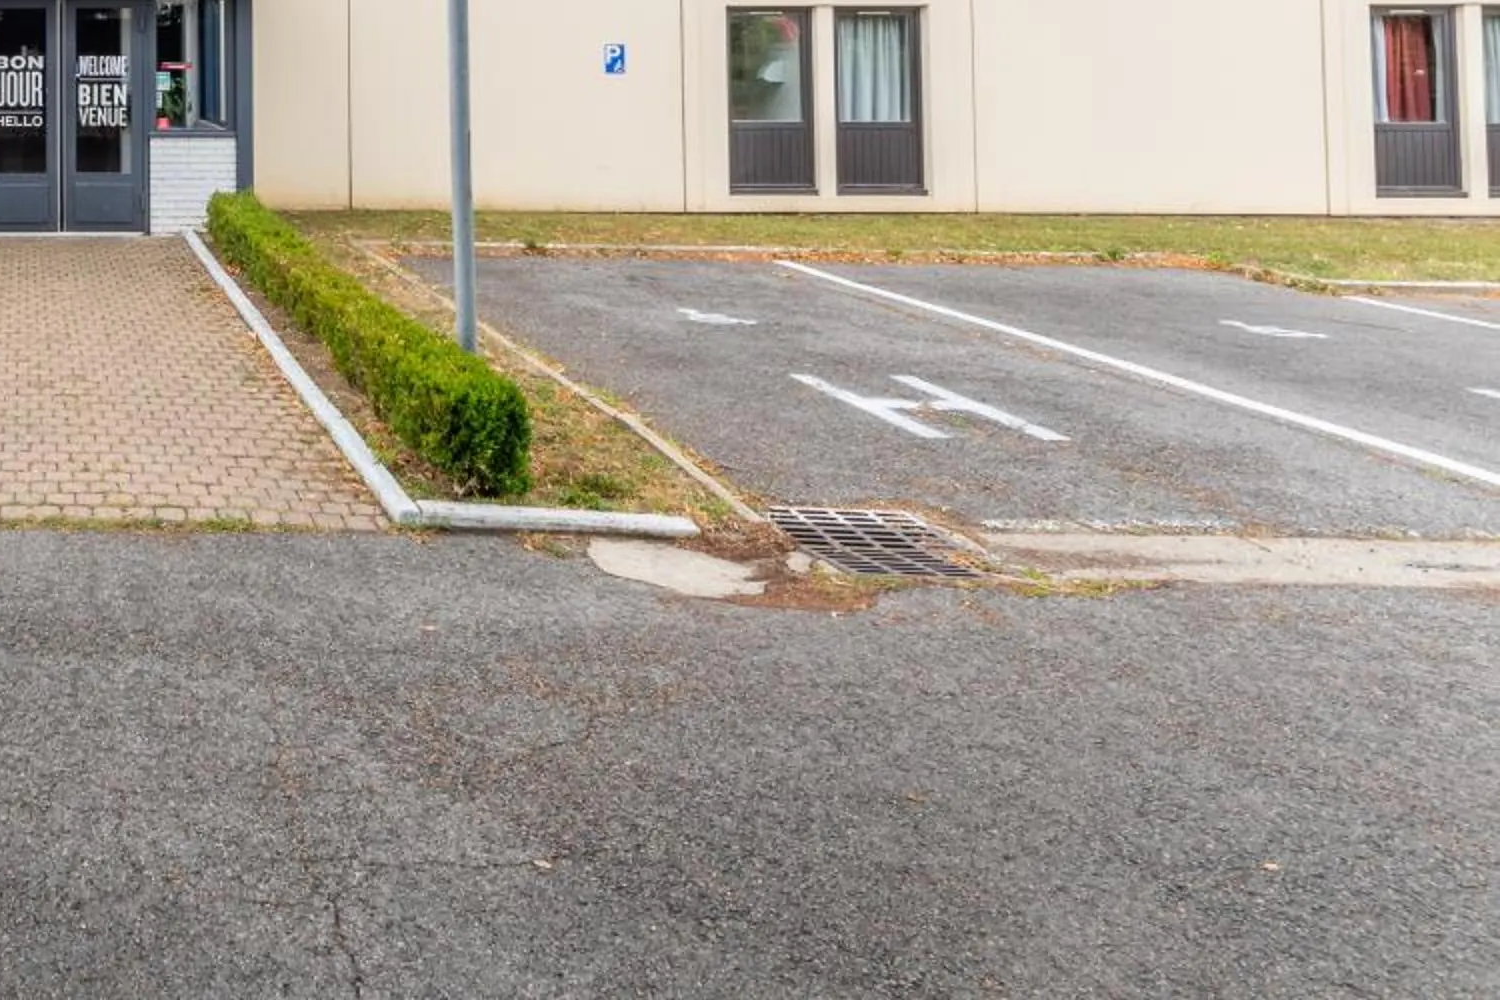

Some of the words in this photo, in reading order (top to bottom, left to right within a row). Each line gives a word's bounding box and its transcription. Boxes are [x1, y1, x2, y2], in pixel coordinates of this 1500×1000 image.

[77, 55, 128, 77] WELCOME
[606, 46, 621, 65] P
[78, 83, 127, 106] BIEN
[78, 106, 127, 127] VENUE
